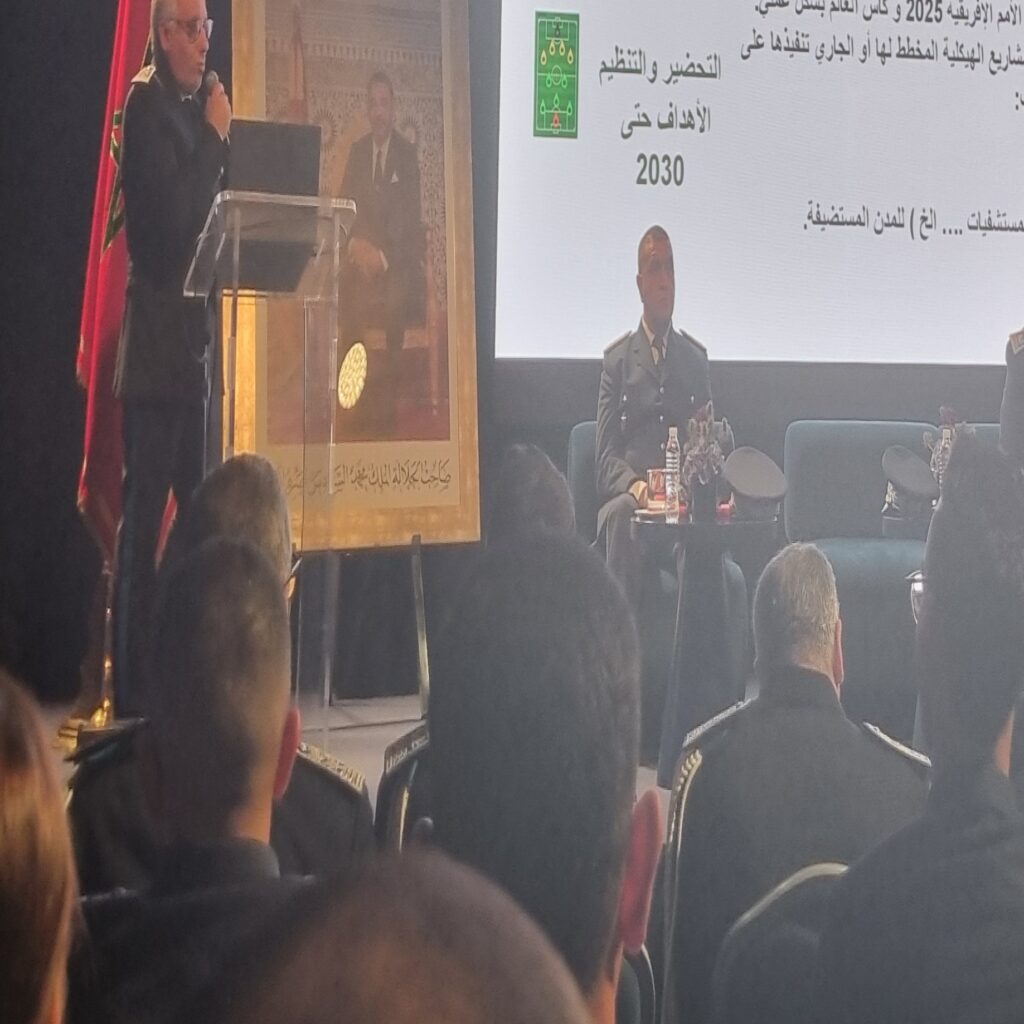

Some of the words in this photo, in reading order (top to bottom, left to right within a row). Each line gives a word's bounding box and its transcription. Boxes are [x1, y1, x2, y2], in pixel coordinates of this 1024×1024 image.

[892, 4, 901, 23] و
[997, 0, 1021, 31] الأمم
[741, 28, 764, 60] على
[770, 27, 810, 58] تنفيذها
[815, 34, 854, 64] الجاري
[859, 30, 871, 64] أو
[875, 36, 892, 60] لها
[896, 35, 938, 61] المخطط
[943, 37, 984, 71] الهيكلية
[599, 45, 657, 85] والتنظيم
[662, 52, 721, 85] التحضير
[621, 103, 652, 140] حتى
[657, 98, 710, 133] الأهداف
[636, 153, 684, 186] 2030
[804, 200, 869, 231] المستضيفة.
[873, 206, 905, 235] للمدن
[919, 208, 936, 241] الخ
